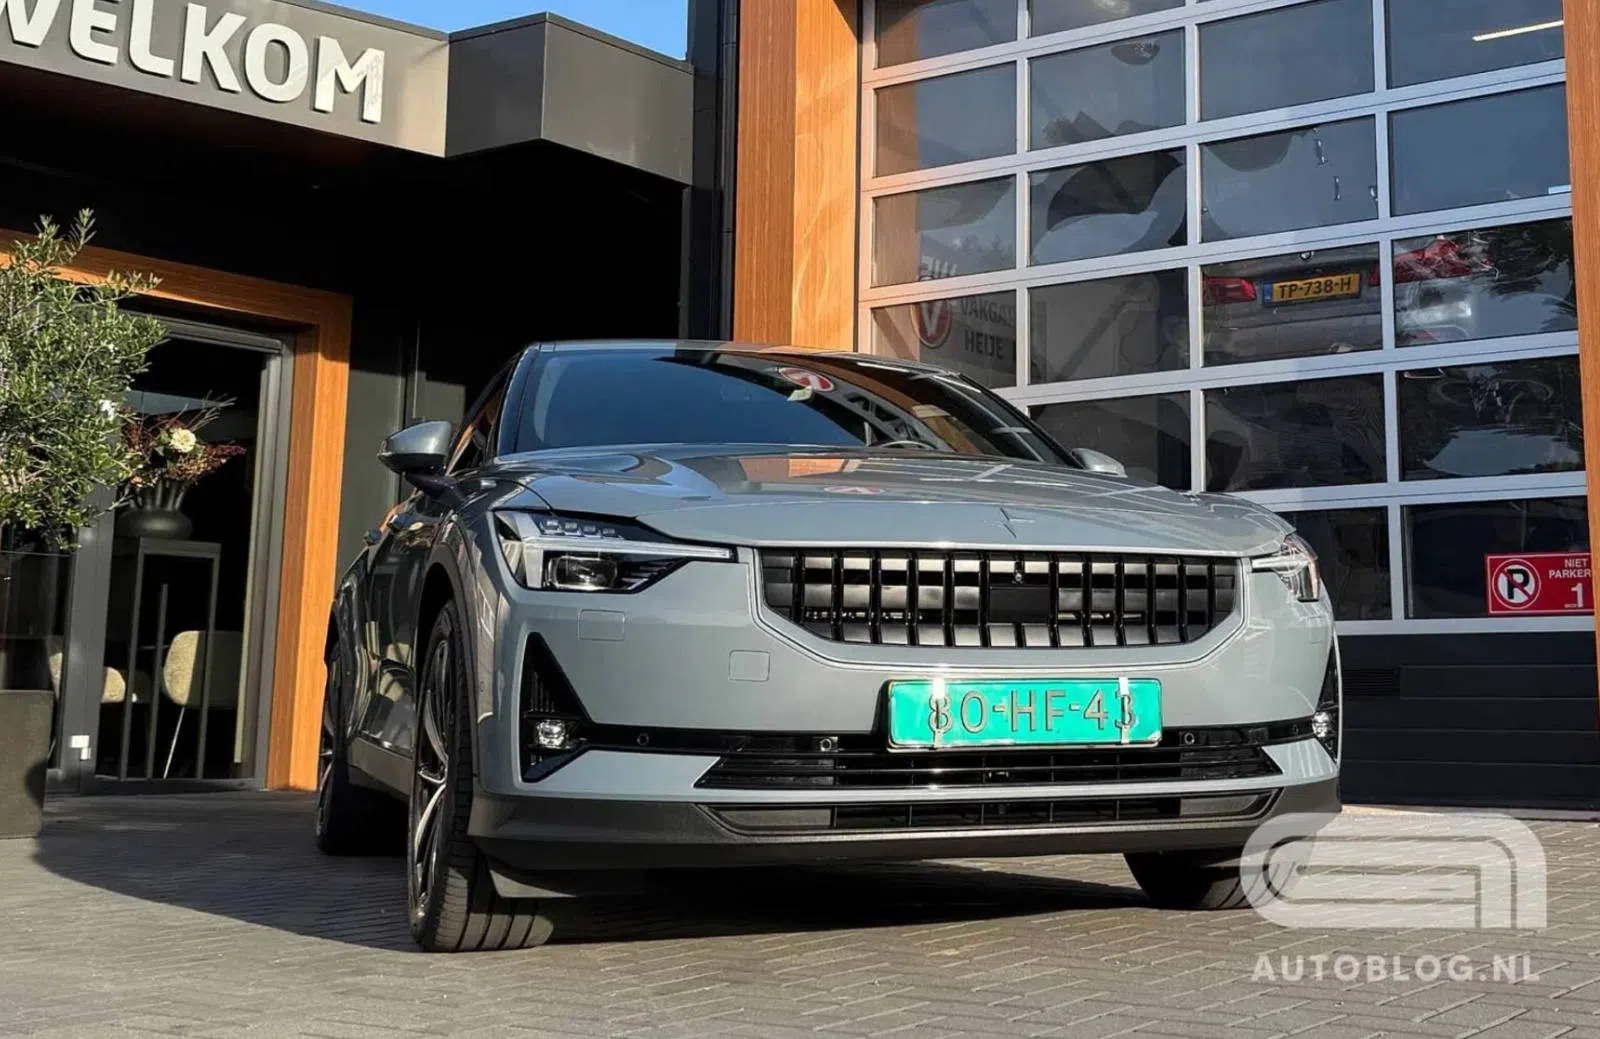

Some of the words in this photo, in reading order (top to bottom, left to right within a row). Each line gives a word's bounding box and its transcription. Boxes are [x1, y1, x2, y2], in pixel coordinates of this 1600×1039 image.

[1279, 276, 1352, 299] TP-738-H
[1564, 558, 1589, 568] NIET
[928, 689, 1136, 734] 80-HF-43
